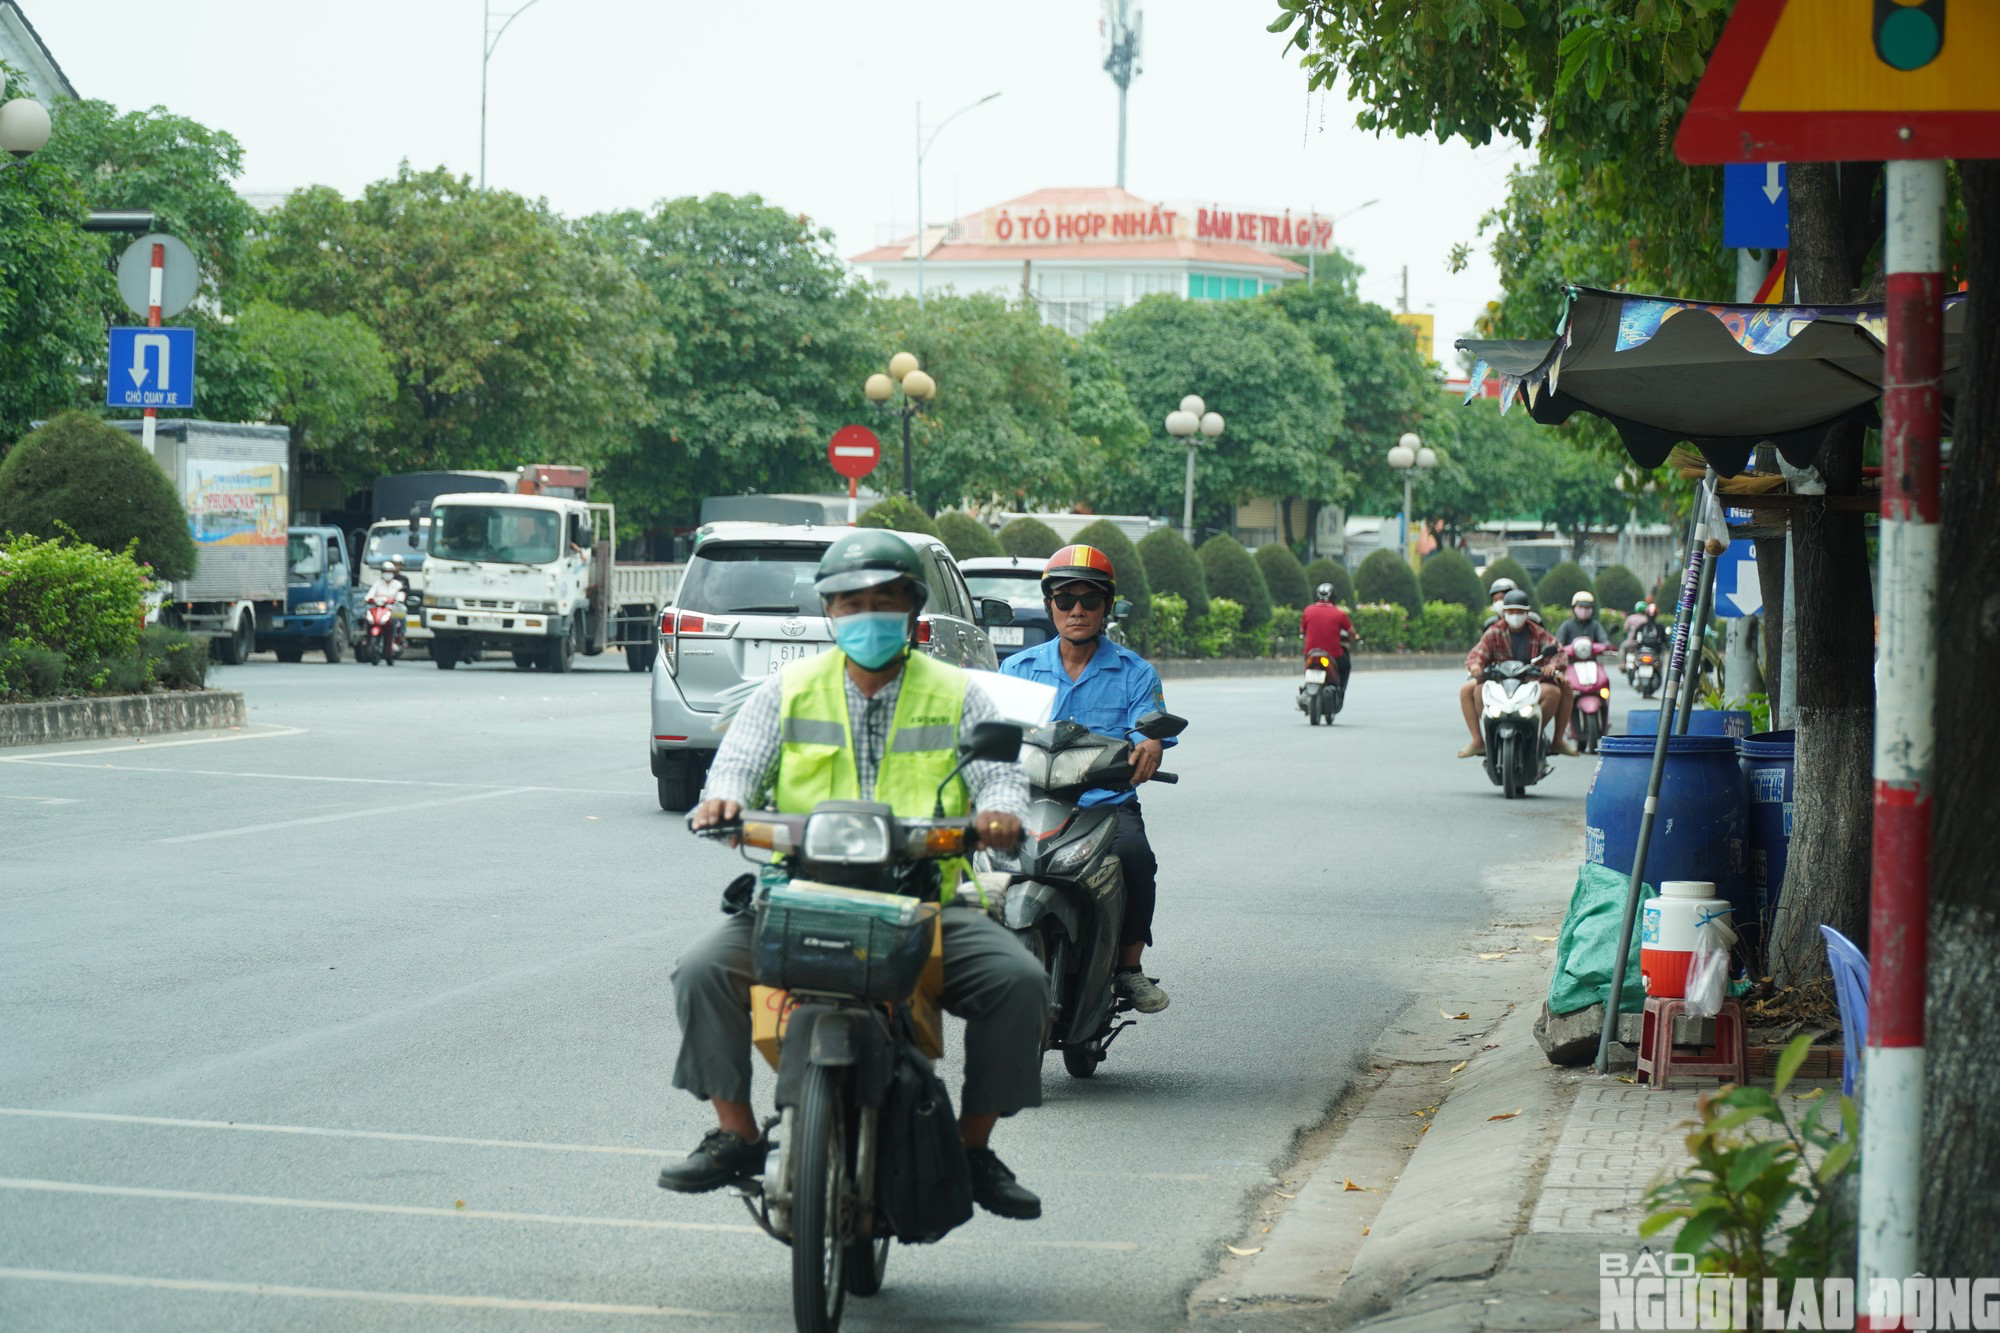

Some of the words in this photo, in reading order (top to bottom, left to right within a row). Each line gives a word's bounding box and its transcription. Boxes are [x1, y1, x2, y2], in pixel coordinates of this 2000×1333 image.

[1236, 213, 1257, 241] XE
[143, 391, 165, 404] QUAY
[166, 392, 178, 405] XE
[780, 645, 805, 661] 61A
